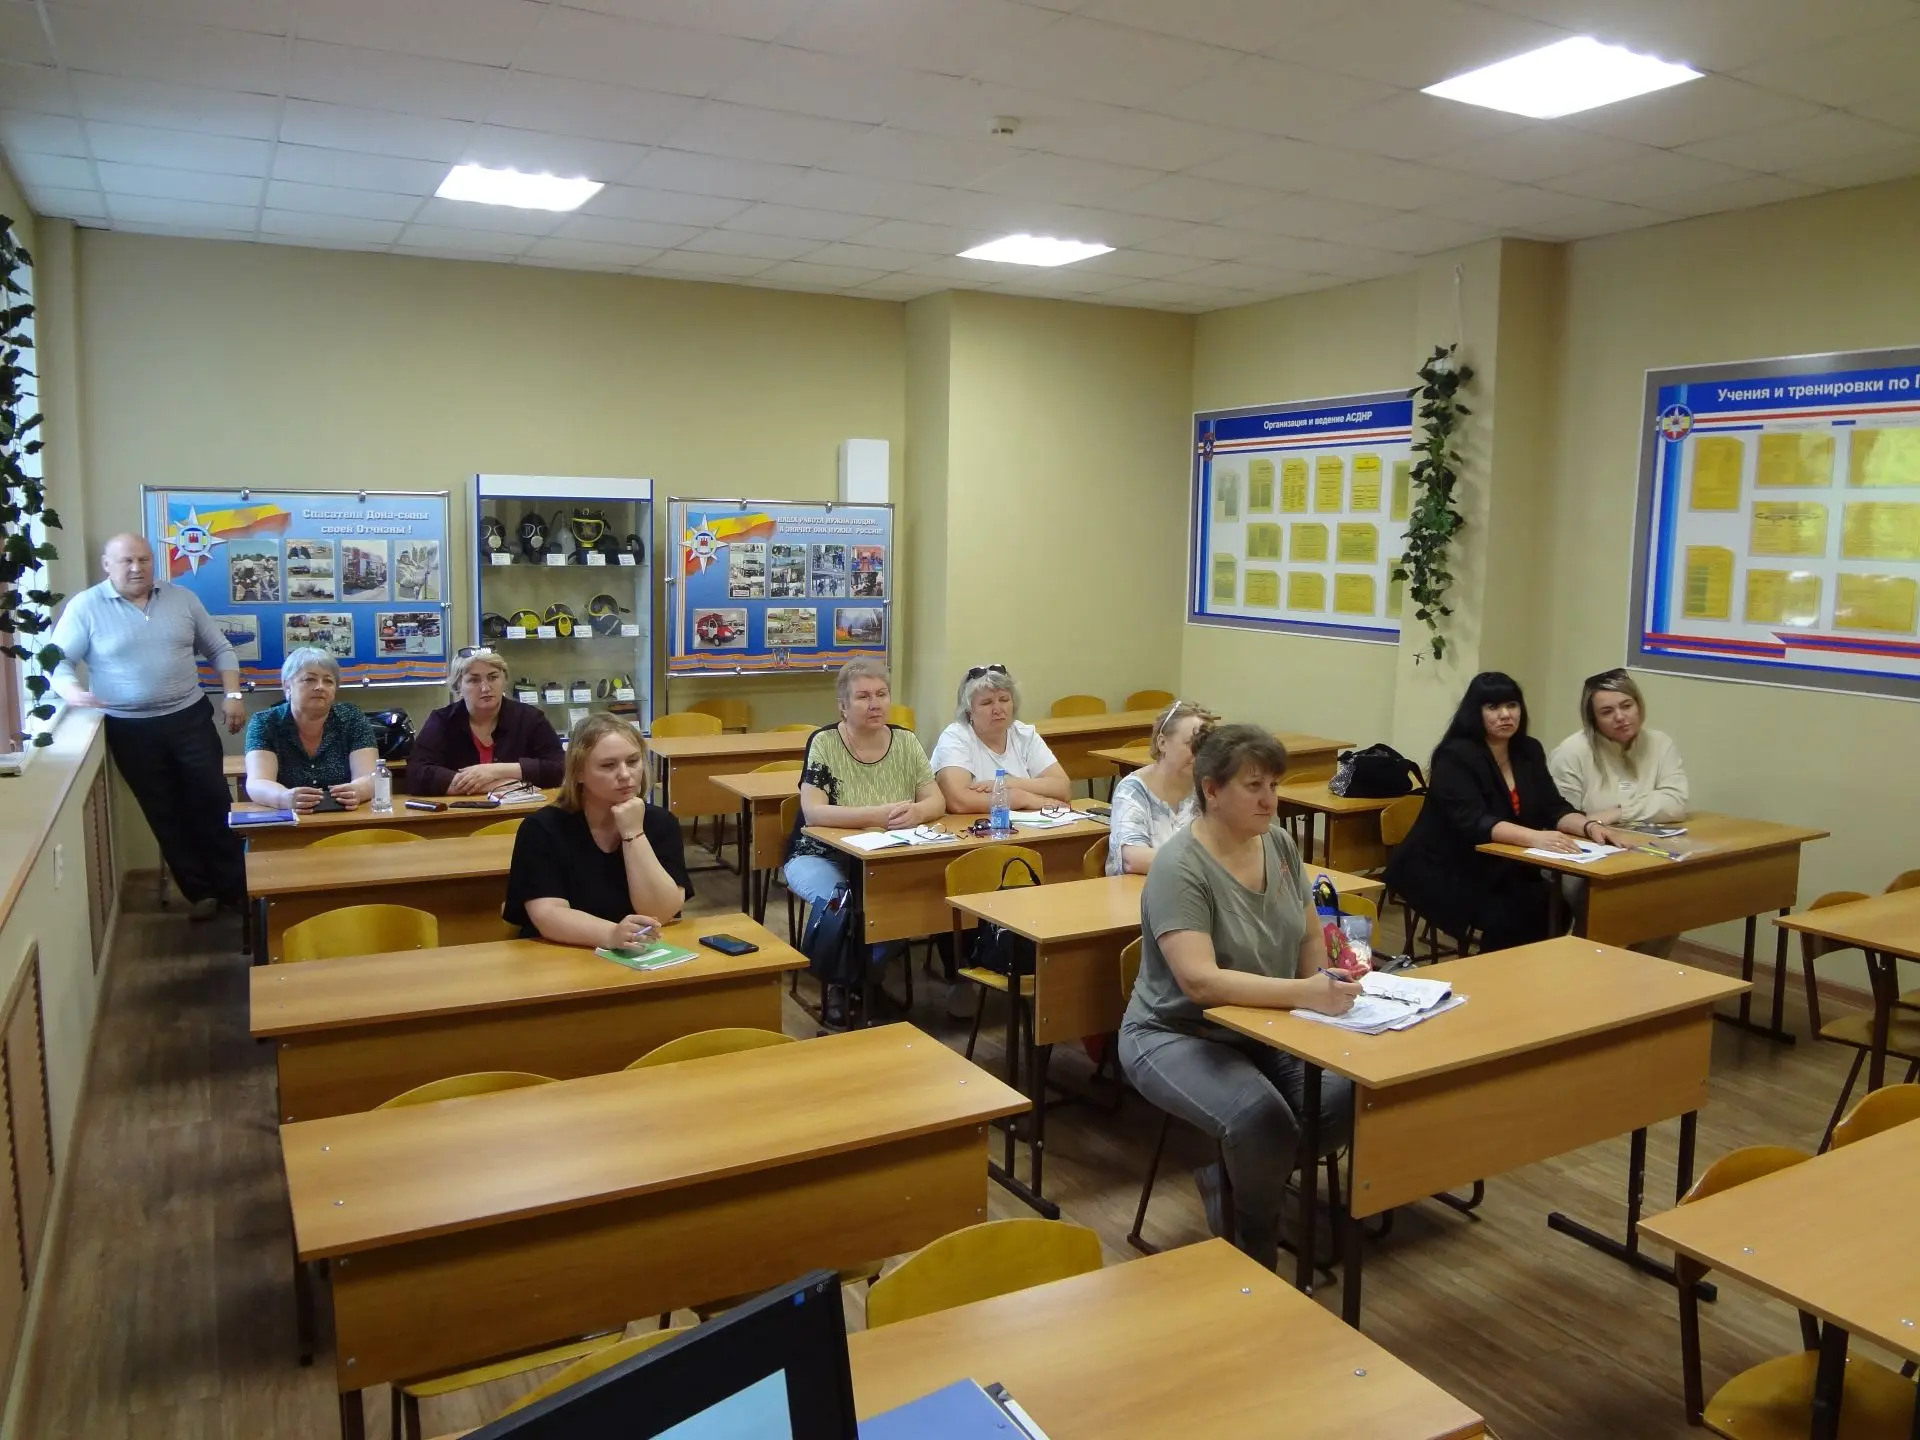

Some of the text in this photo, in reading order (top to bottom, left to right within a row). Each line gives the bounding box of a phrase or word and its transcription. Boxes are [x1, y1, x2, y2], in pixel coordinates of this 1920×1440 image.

[1717, 388, 1770, 402] Учения
[1774, 387, 1784, 398] и
[1787, 380, 1883, 400] тренировки
[1888, 378, 1910, 391] по
[1263, 419, 1307, 431] Организация
[1308, 418, 1314, 426] и
[1345, 411, 1373, 423] АСДНР
